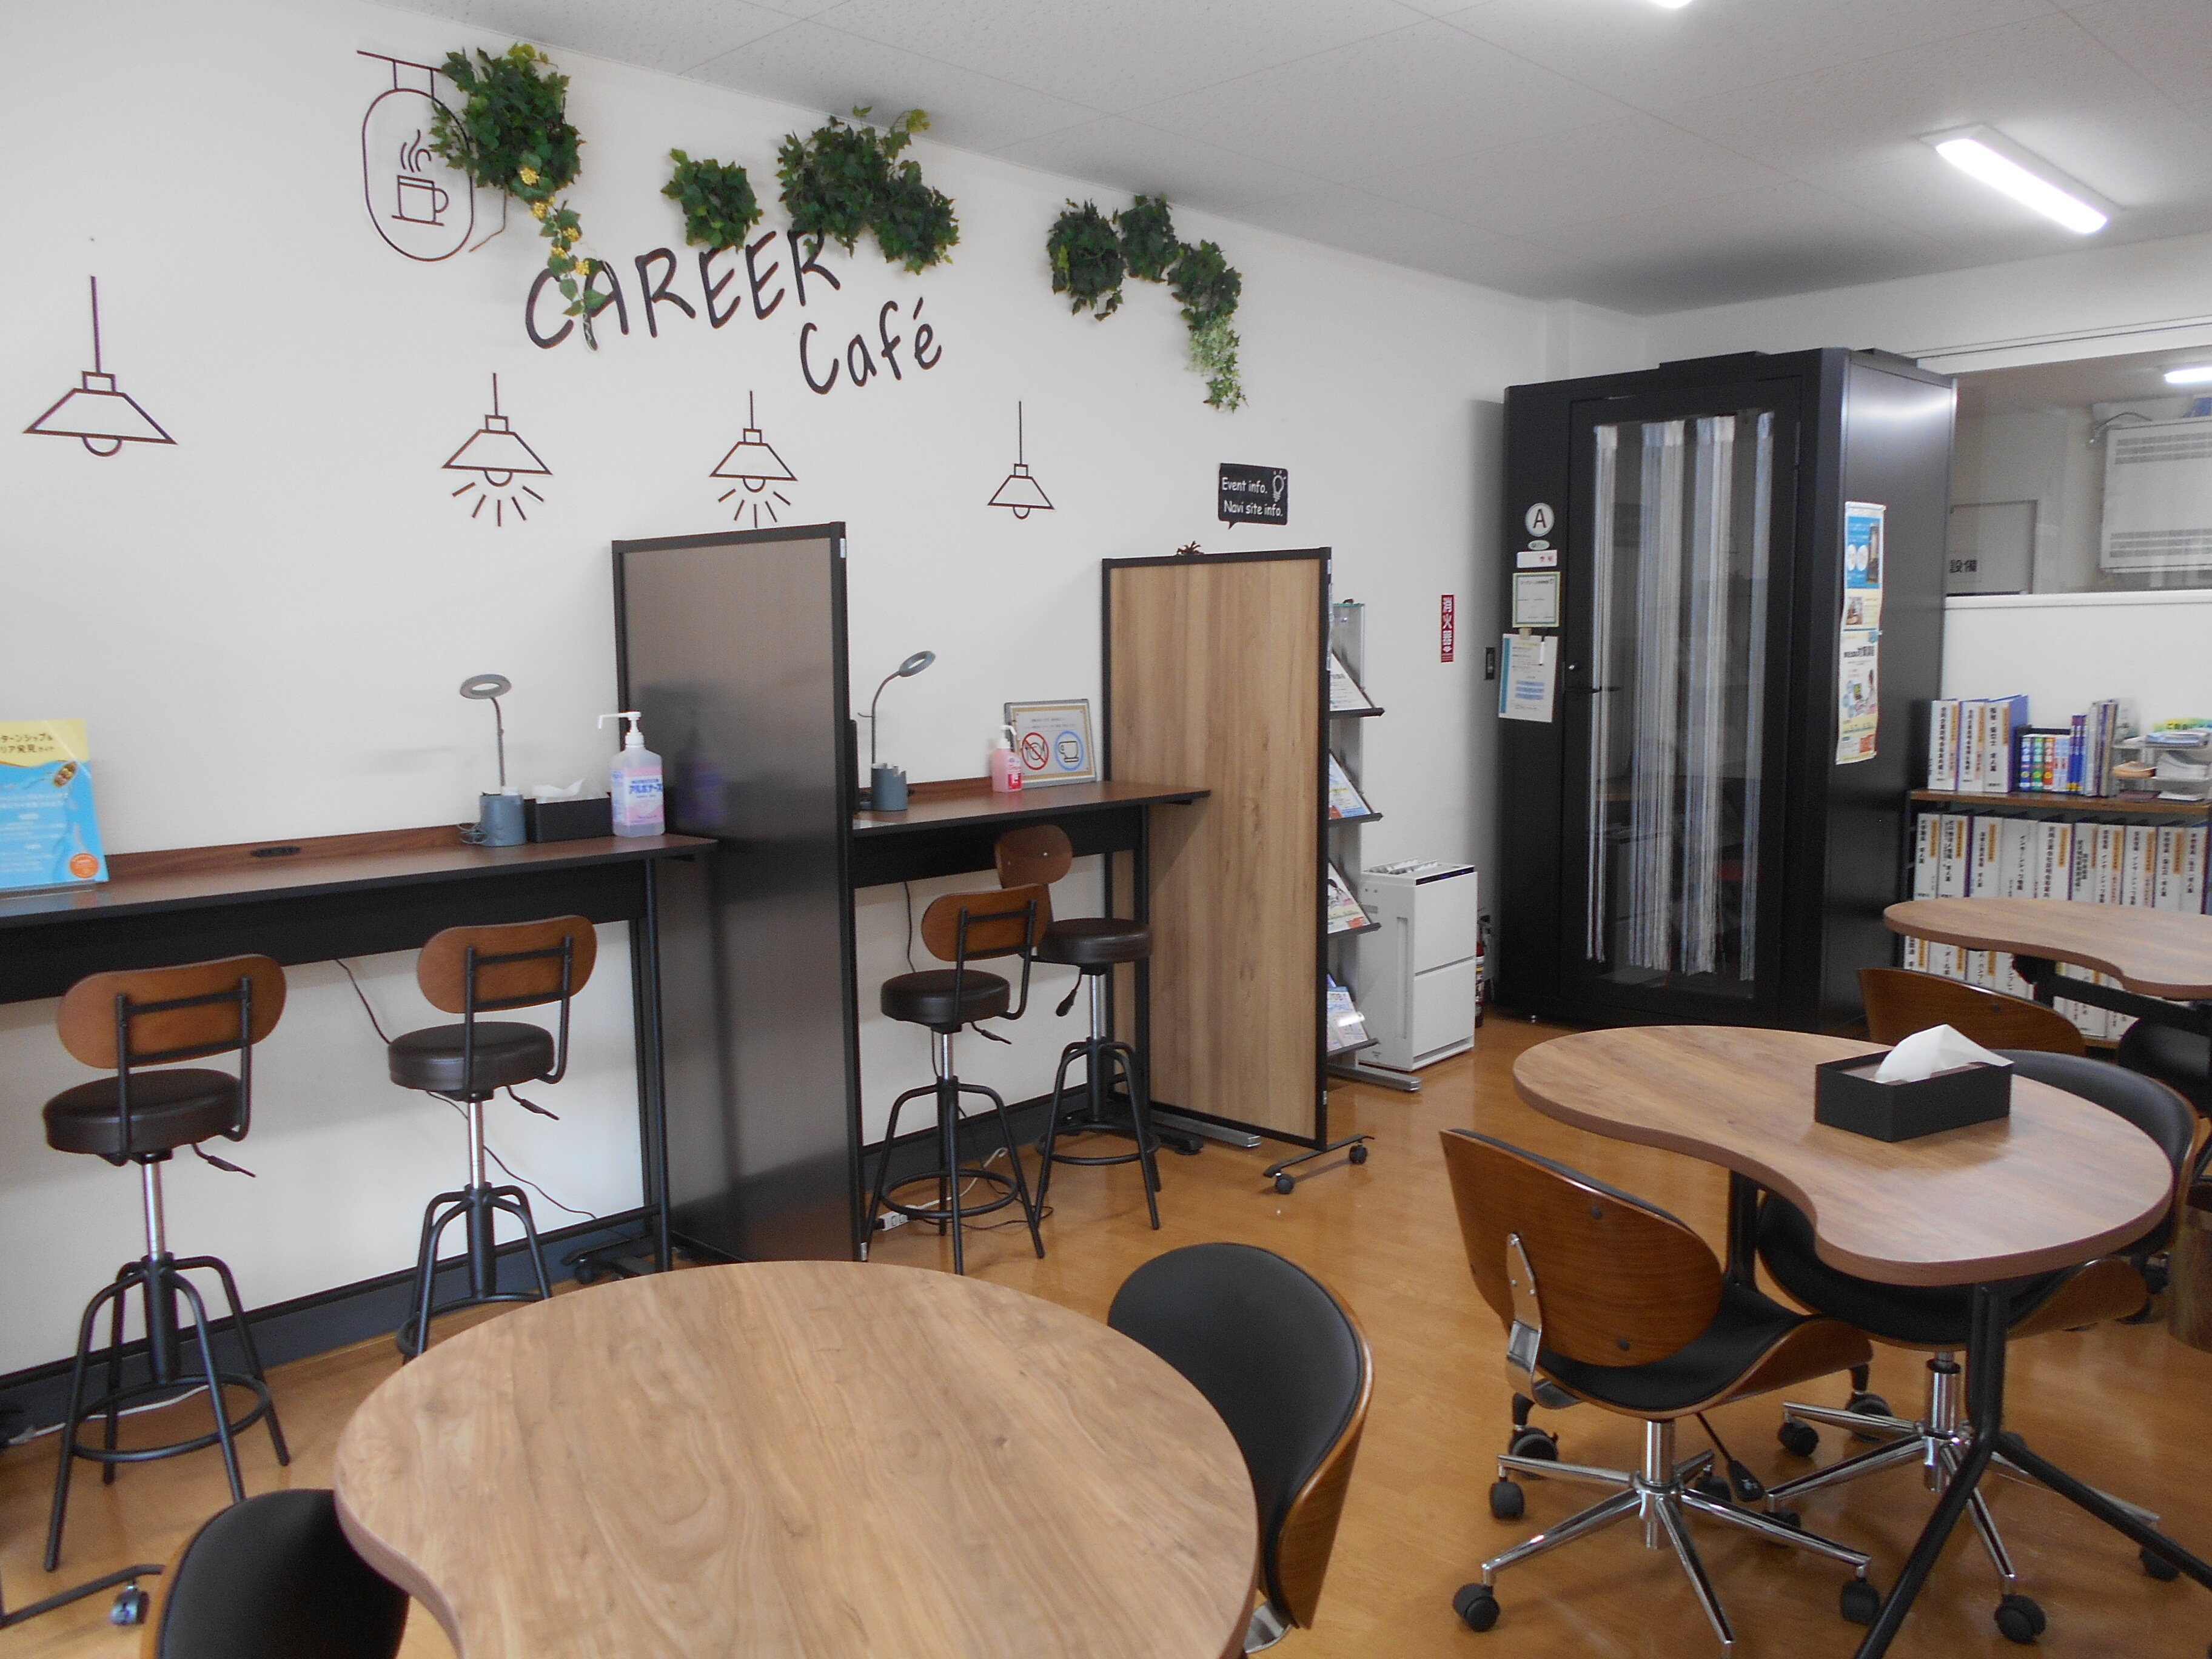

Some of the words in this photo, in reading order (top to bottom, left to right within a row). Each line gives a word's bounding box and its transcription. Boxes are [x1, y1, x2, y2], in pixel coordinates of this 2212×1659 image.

[525, 230, 840, 351] CAREER
[799, 297, 942, 395] Café
[1221, 477, 1247, 492] Event
[1248, 480, 1268, 494] info.
[1224, 500, 1244, 514] Navi
[1245, 503, 1263, 515] site
[1264, 503, 1283, 517] info.
[1533, 509, 1547, 529] A
